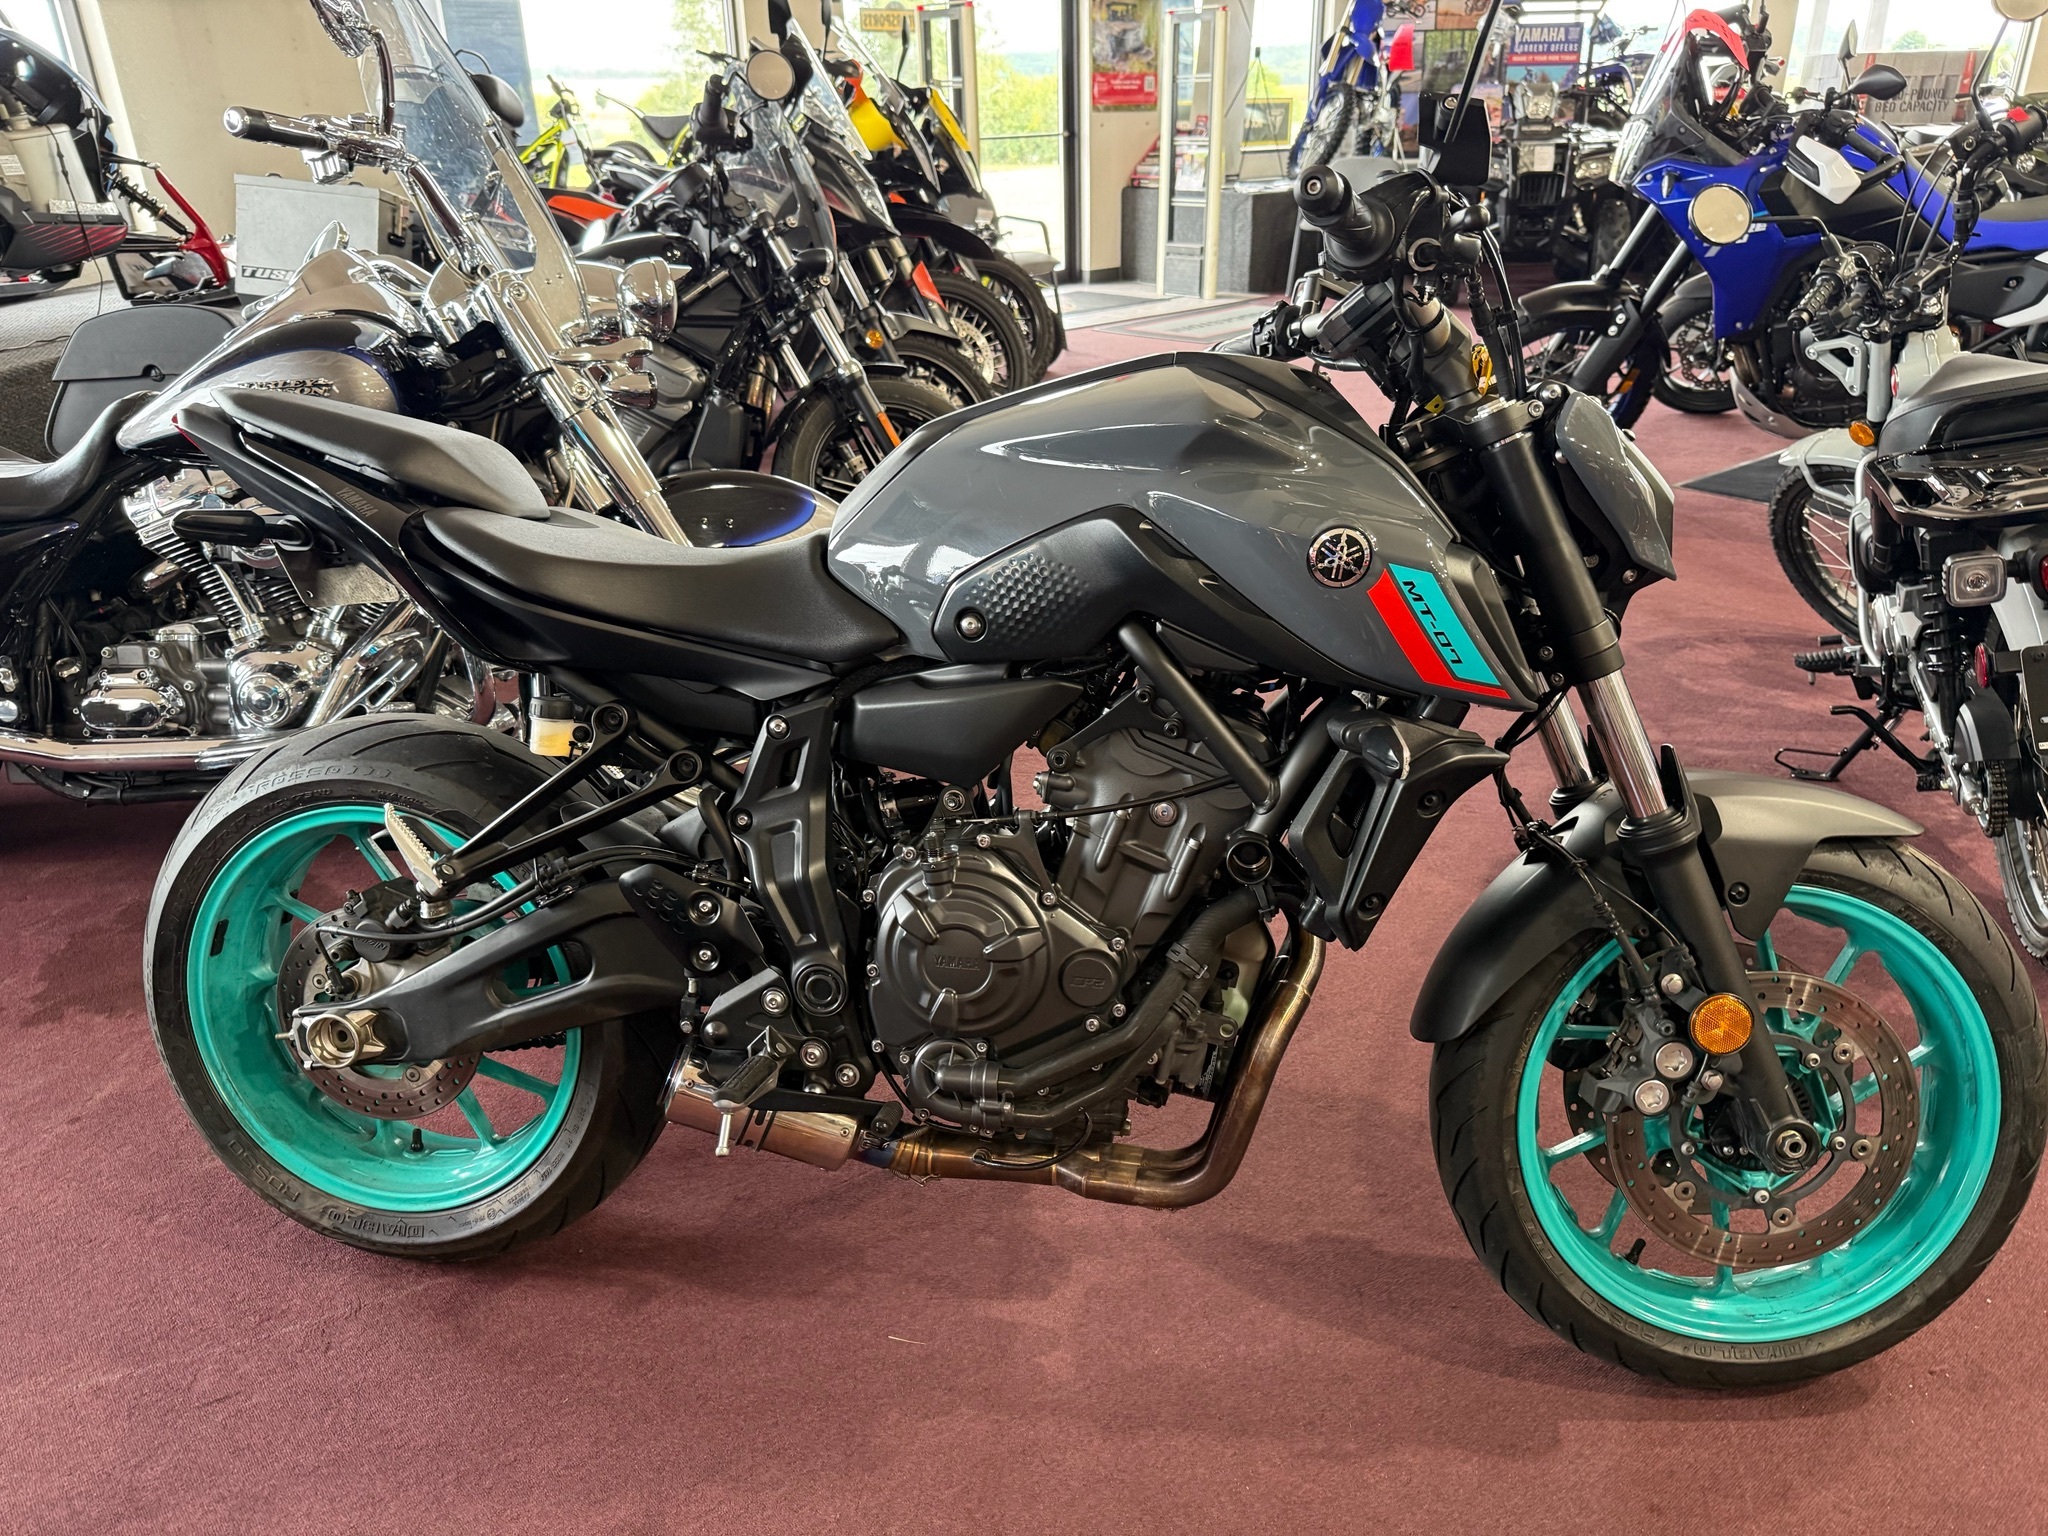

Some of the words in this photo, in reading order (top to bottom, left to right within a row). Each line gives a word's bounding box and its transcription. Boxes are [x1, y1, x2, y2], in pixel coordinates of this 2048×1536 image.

[1516, 27, 1566, 42] YAMAHA
[1550, 43, 1579, 52] OFFERS
[1875, 101, 1896, 113] BED
[1899, 101, 1949, 112] CAPACITY
[242, 266, 294, 281] TUS
[336, 487, 379, 518] YAMAHA
[1402, 580, 1464, 665] MT-07
[933, 954, 981, 970] YAMAHA
[227, 1138, 301, 1203] ROSSO
[1580, 1289, 1658, 1343] ROSSO
